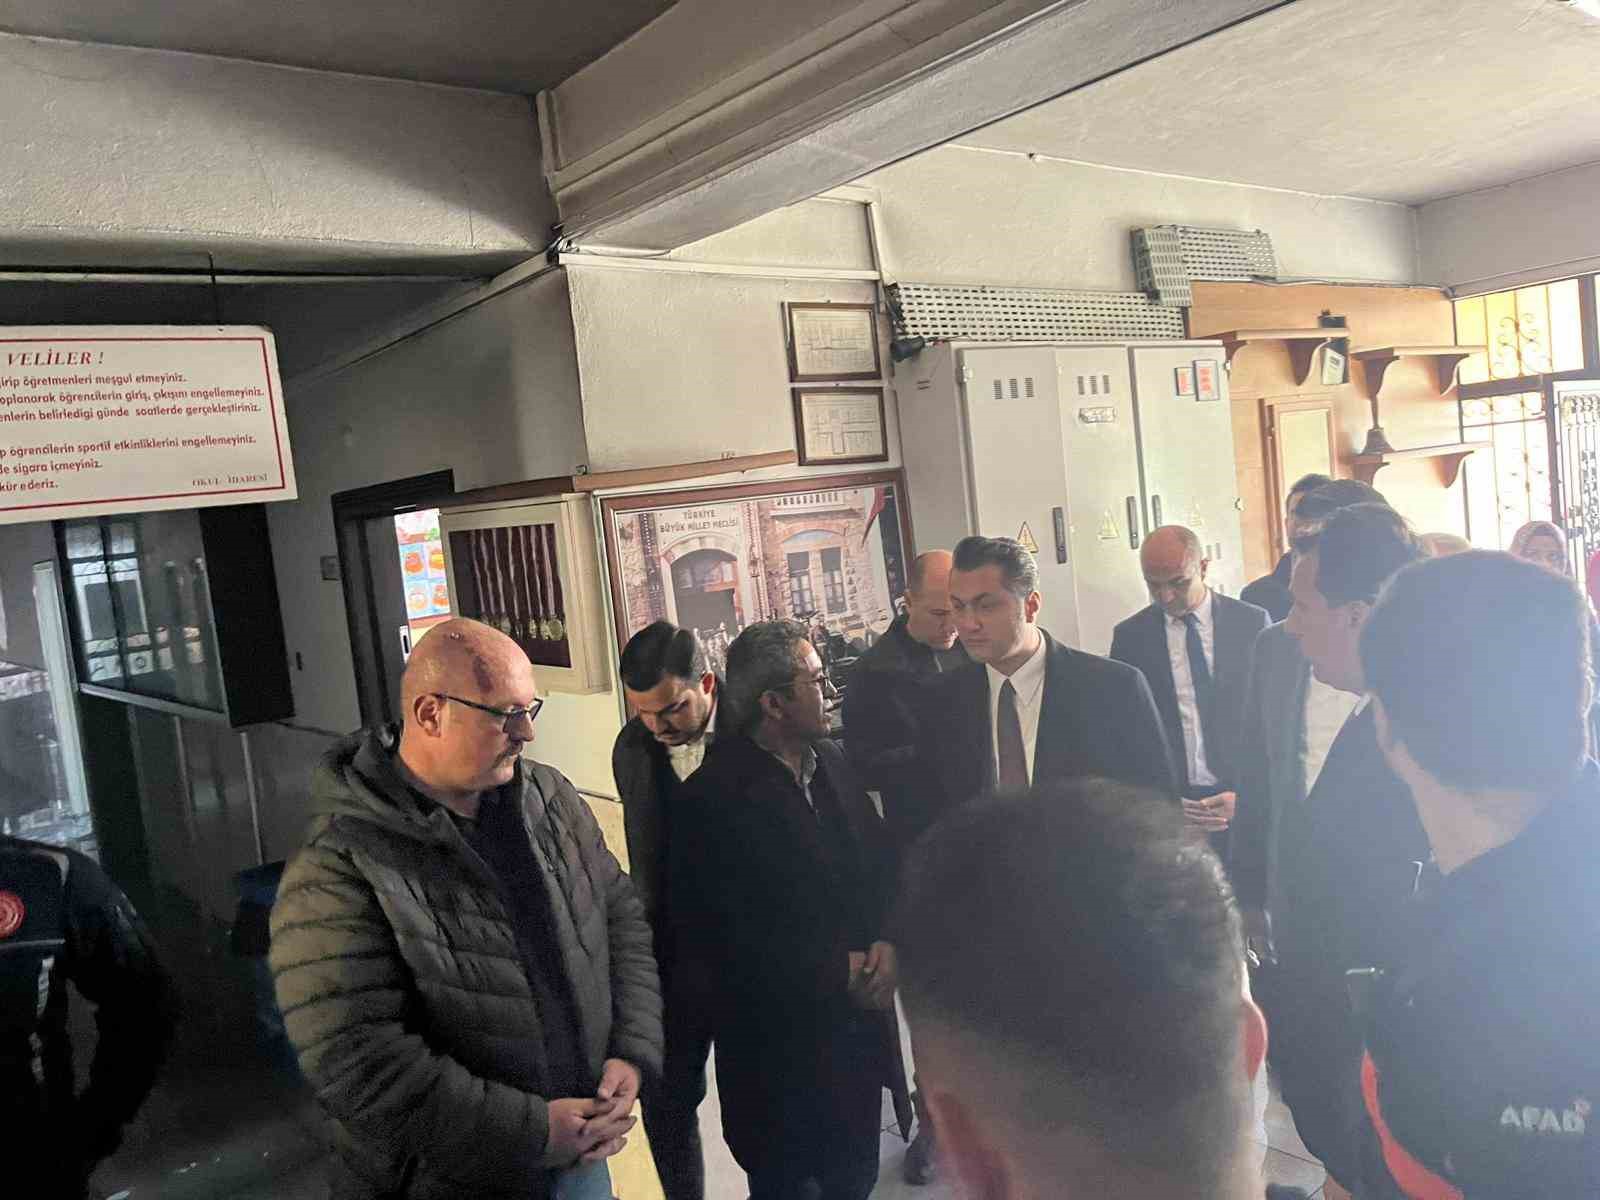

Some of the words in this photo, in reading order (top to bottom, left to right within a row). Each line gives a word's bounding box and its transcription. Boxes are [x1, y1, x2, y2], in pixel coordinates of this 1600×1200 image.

[8, 348, 92, 366] VELİLER
[98, 351, 104, 365] !
[23, 373, 92, 389] öğretmenleri
[96, 373, 133, 387] meşgul
[135, 371, 187, 386] etmeyiniz.
[125, 388, 151, 402] giriş,
[190, 386, 265, 399] engellemeyiniz.
[96, 406, 129, 421] günde
[135, 404, 183, 417] saatlerde
[185, 402, 262, 417] gerçekleştiriniz.
[77, 439, 112, 455] sportif
[114, 437, 179, 451] etkinliklerini
[181, 434, 257, 449] engellemeyiniz.
[13, 461, 48, 476] sigara
[50, 458, 103, 474] içmeyiniz.
